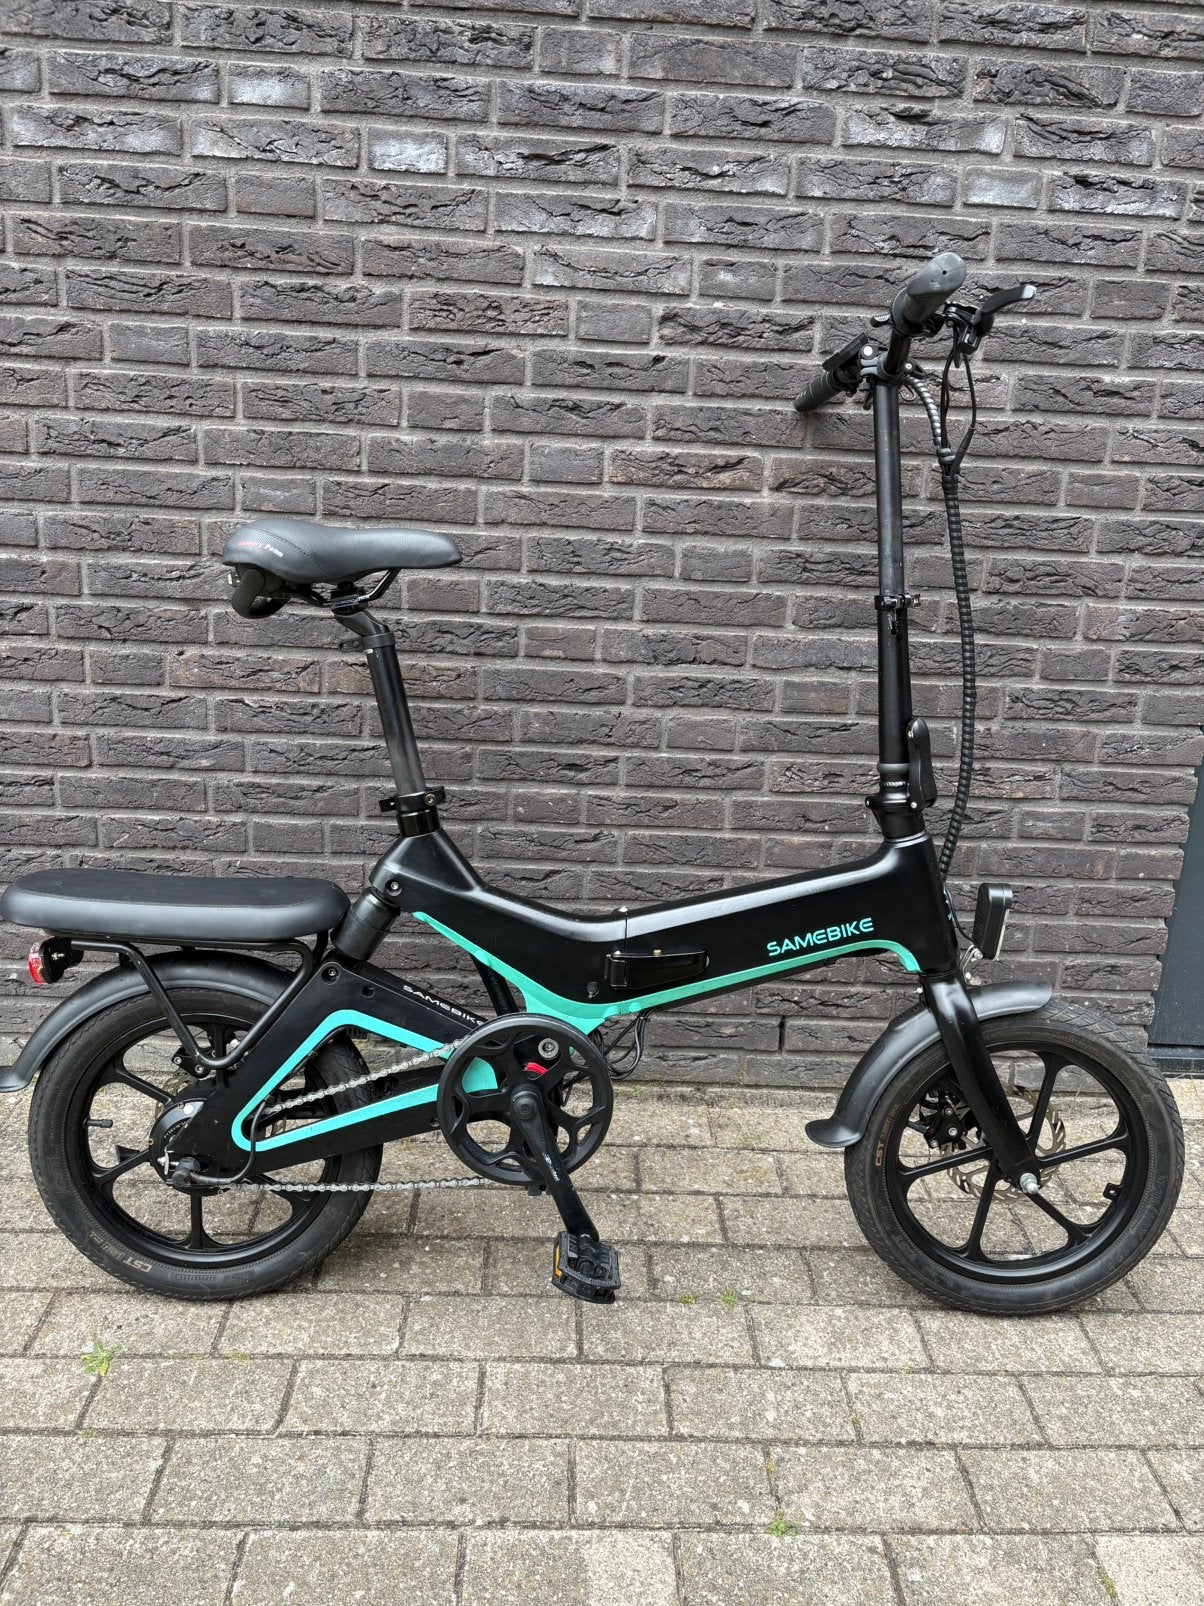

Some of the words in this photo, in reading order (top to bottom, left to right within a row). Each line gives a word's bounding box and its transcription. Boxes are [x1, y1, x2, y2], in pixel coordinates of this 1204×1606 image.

[766, 917, 875, 957] SAMEBIKE
[874, 1139, 885, 1167] CST
[123, 1257, 153, 1273] CST
